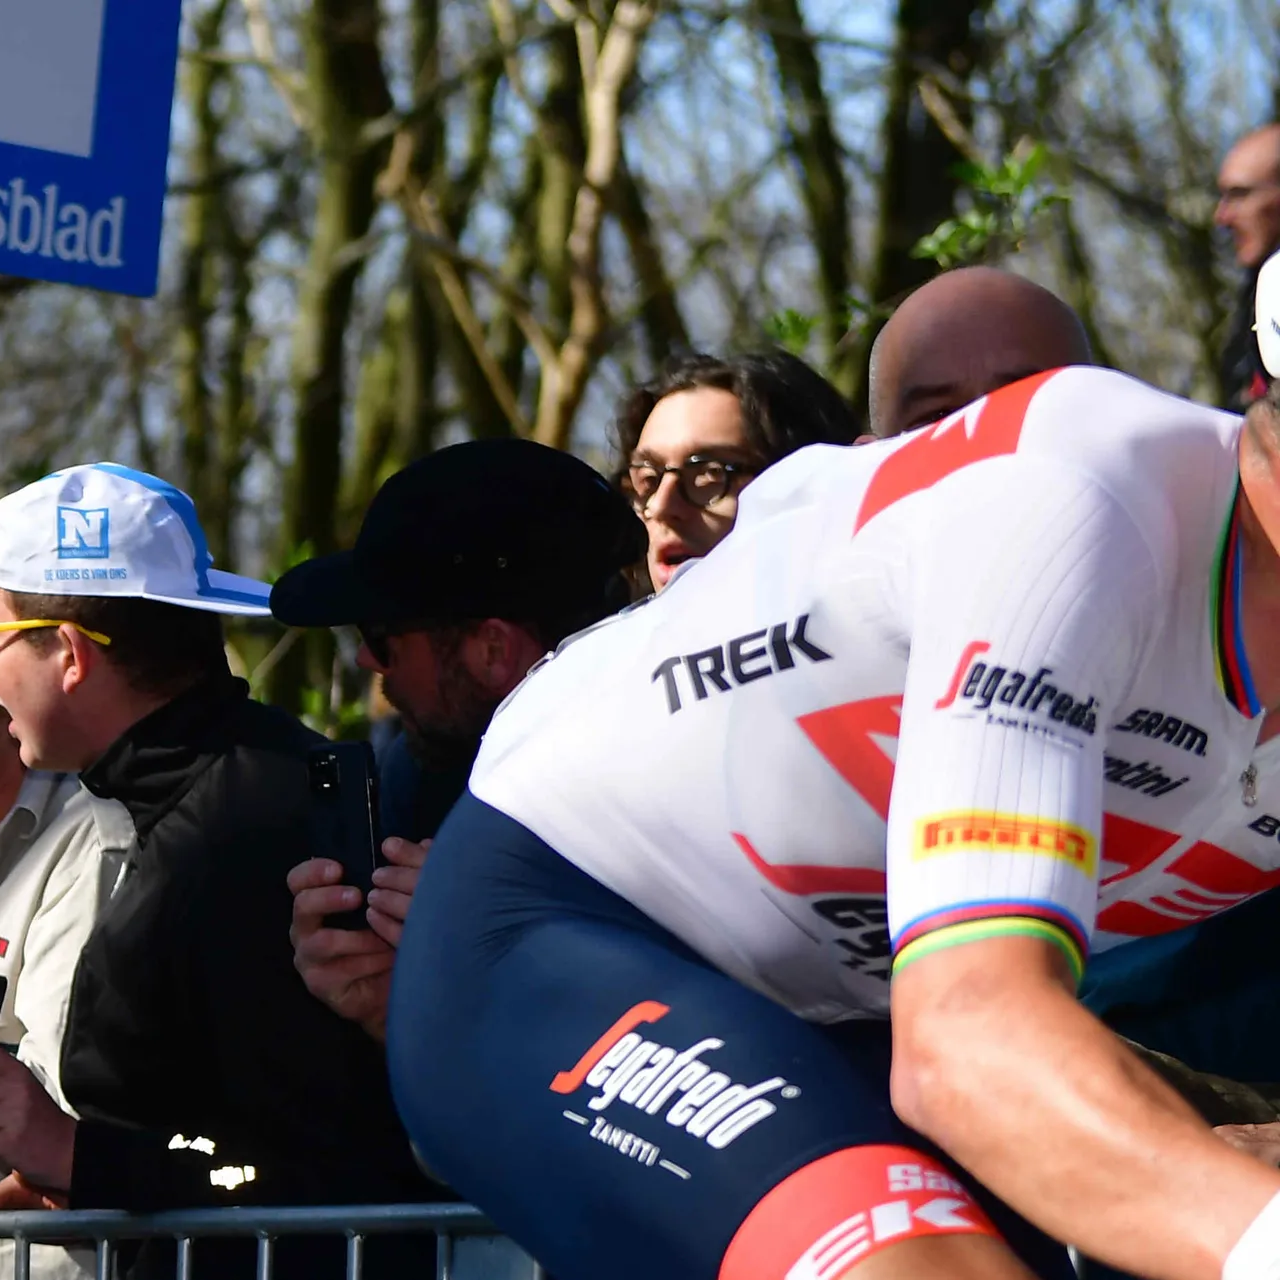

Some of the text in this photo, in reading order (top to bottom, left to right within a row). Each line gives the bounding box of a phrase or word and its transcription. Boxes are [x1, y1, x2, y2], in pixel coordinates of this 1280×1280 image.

[61, 510, 104, 547] N
[652, 614, 832, 714] TREK
[1114, 708, 1207, 757] SRAM
[549, 1000, 787, 1149] Segafredo
[589, 1116, 661, 1167] ZANETTI
